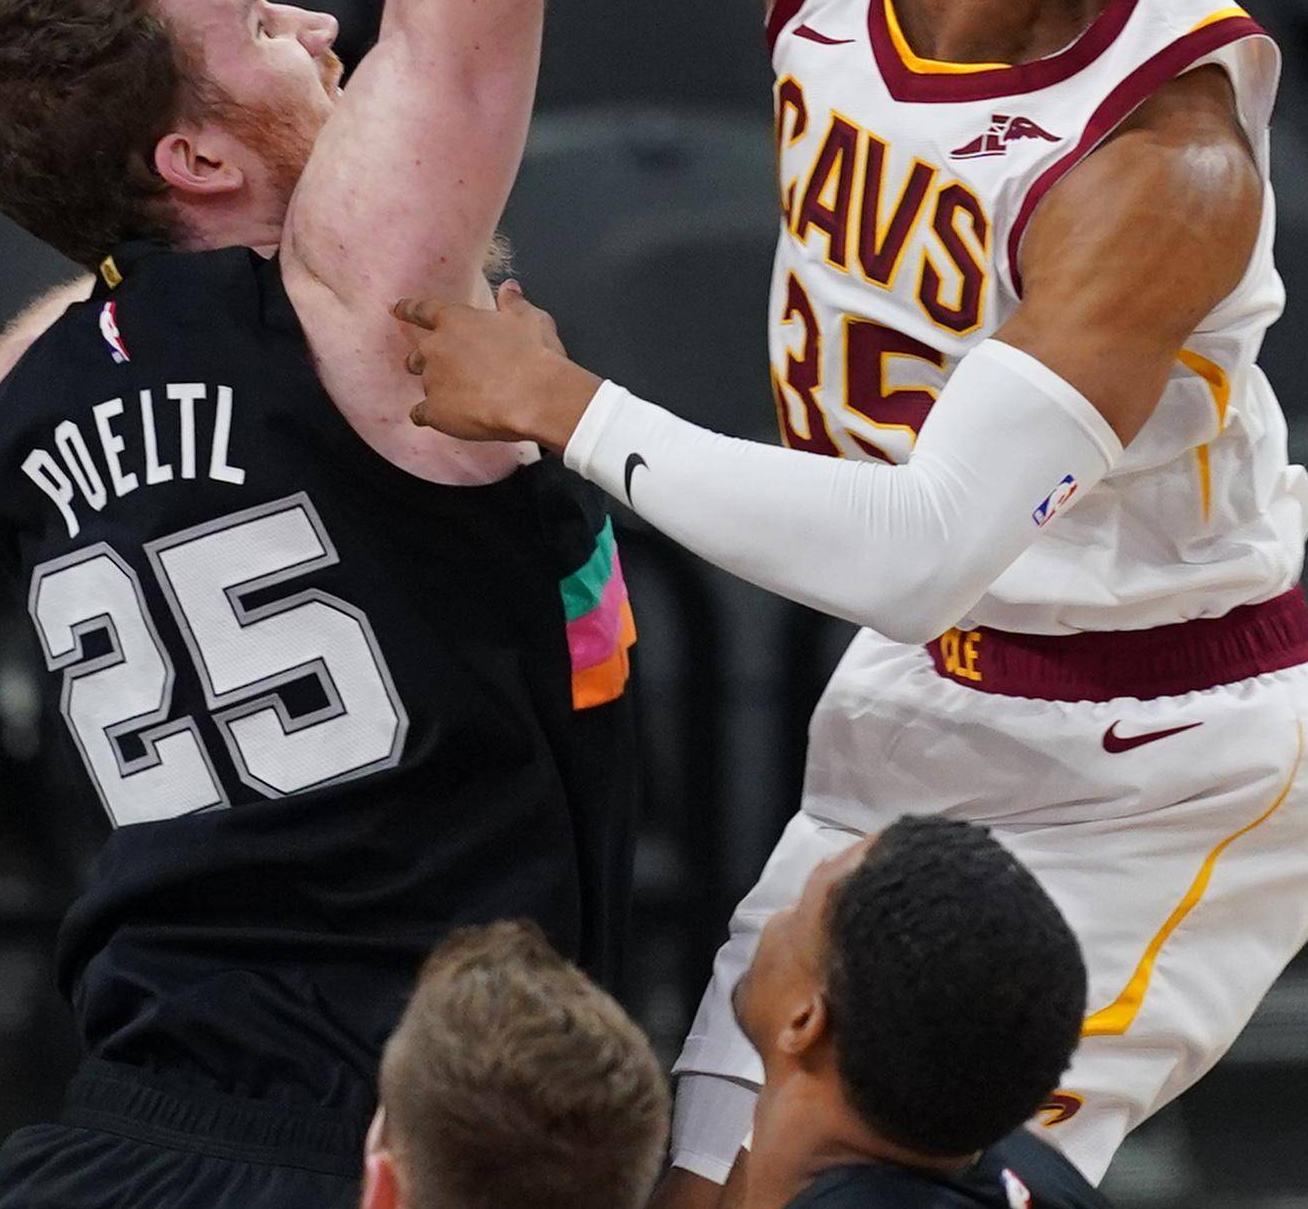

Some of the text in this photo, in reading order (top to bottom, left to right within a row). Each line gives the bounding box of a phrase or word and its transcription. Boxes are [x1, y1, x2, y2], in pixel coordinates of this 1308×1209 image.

[775, 73, 990, 337] CAVS
[20, 382, 246, 539] POELTL
[771, 267, 949, 467] 35
[28, 491, 410, 831] 25
